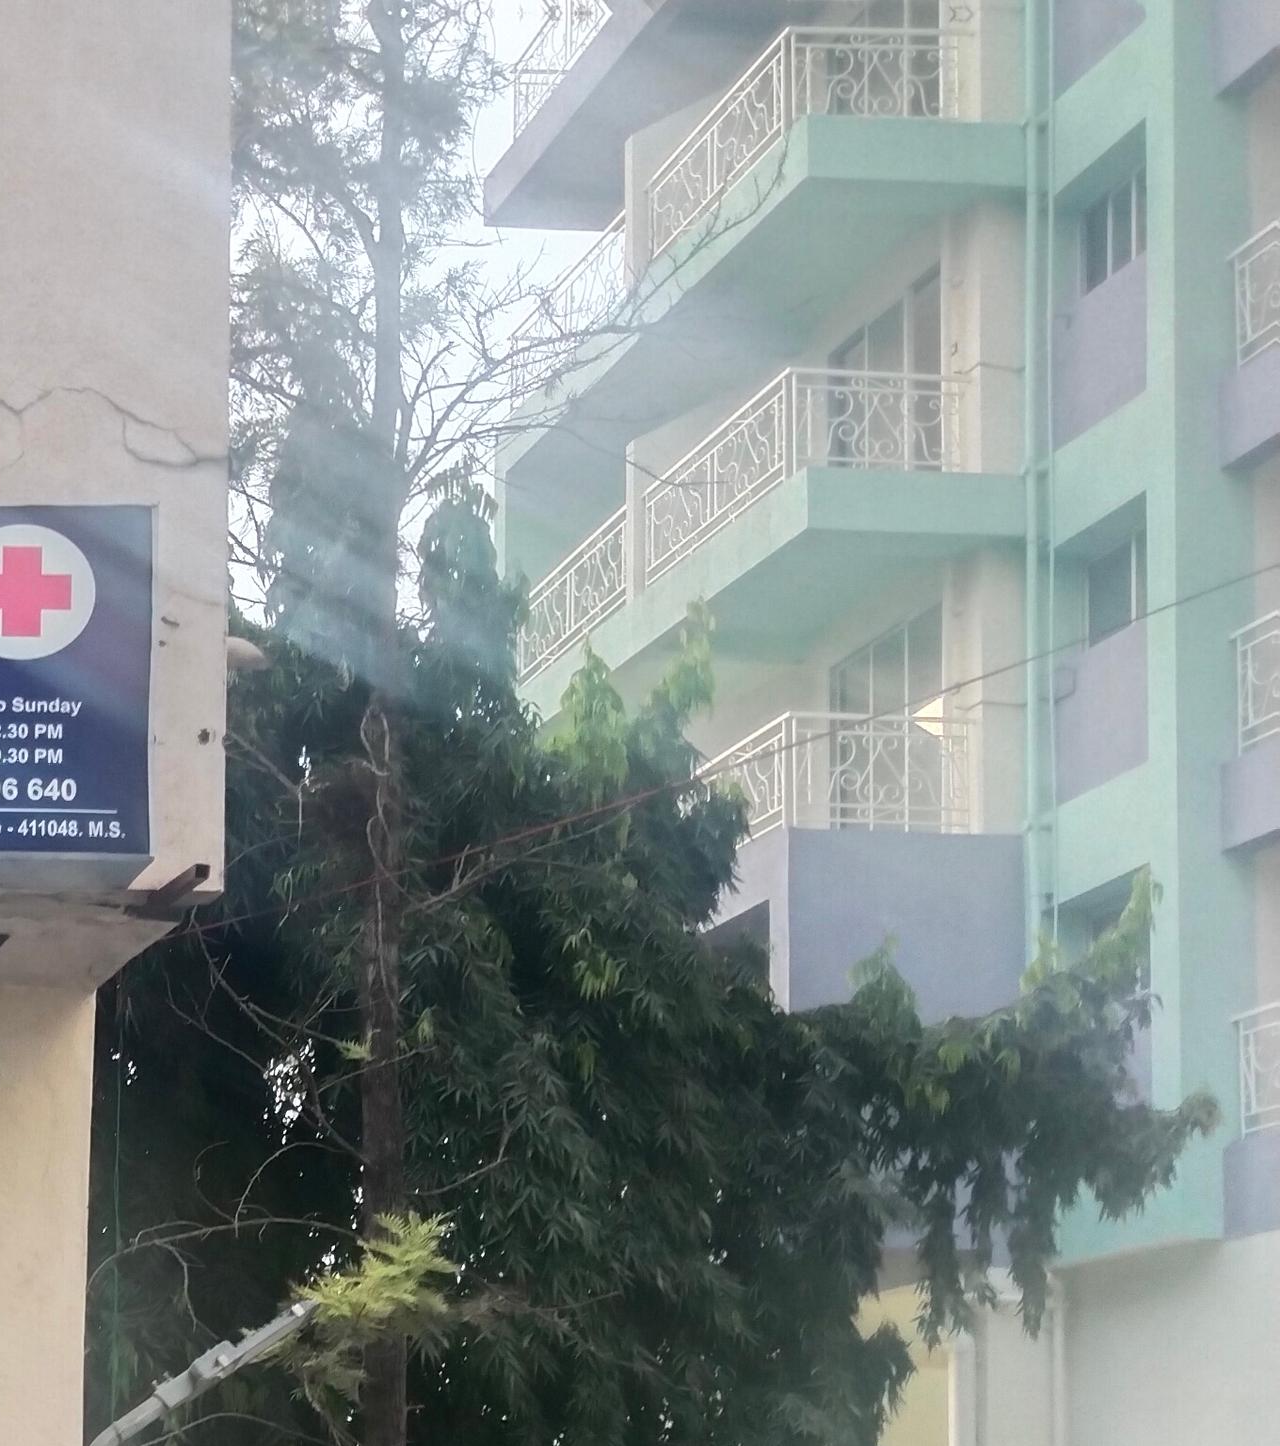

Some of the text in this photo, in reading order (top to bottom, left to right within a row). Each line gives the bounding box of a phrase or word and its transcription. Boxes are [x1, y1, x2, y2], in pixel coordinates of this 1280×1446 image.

[11, 697, 81, 717] Sunday
[34, 724, 63, 739] PM
[34, 749, 63, 764] PM
[27, 778, 77, 801] 640
[88, 822, 126, 838] M.S.
